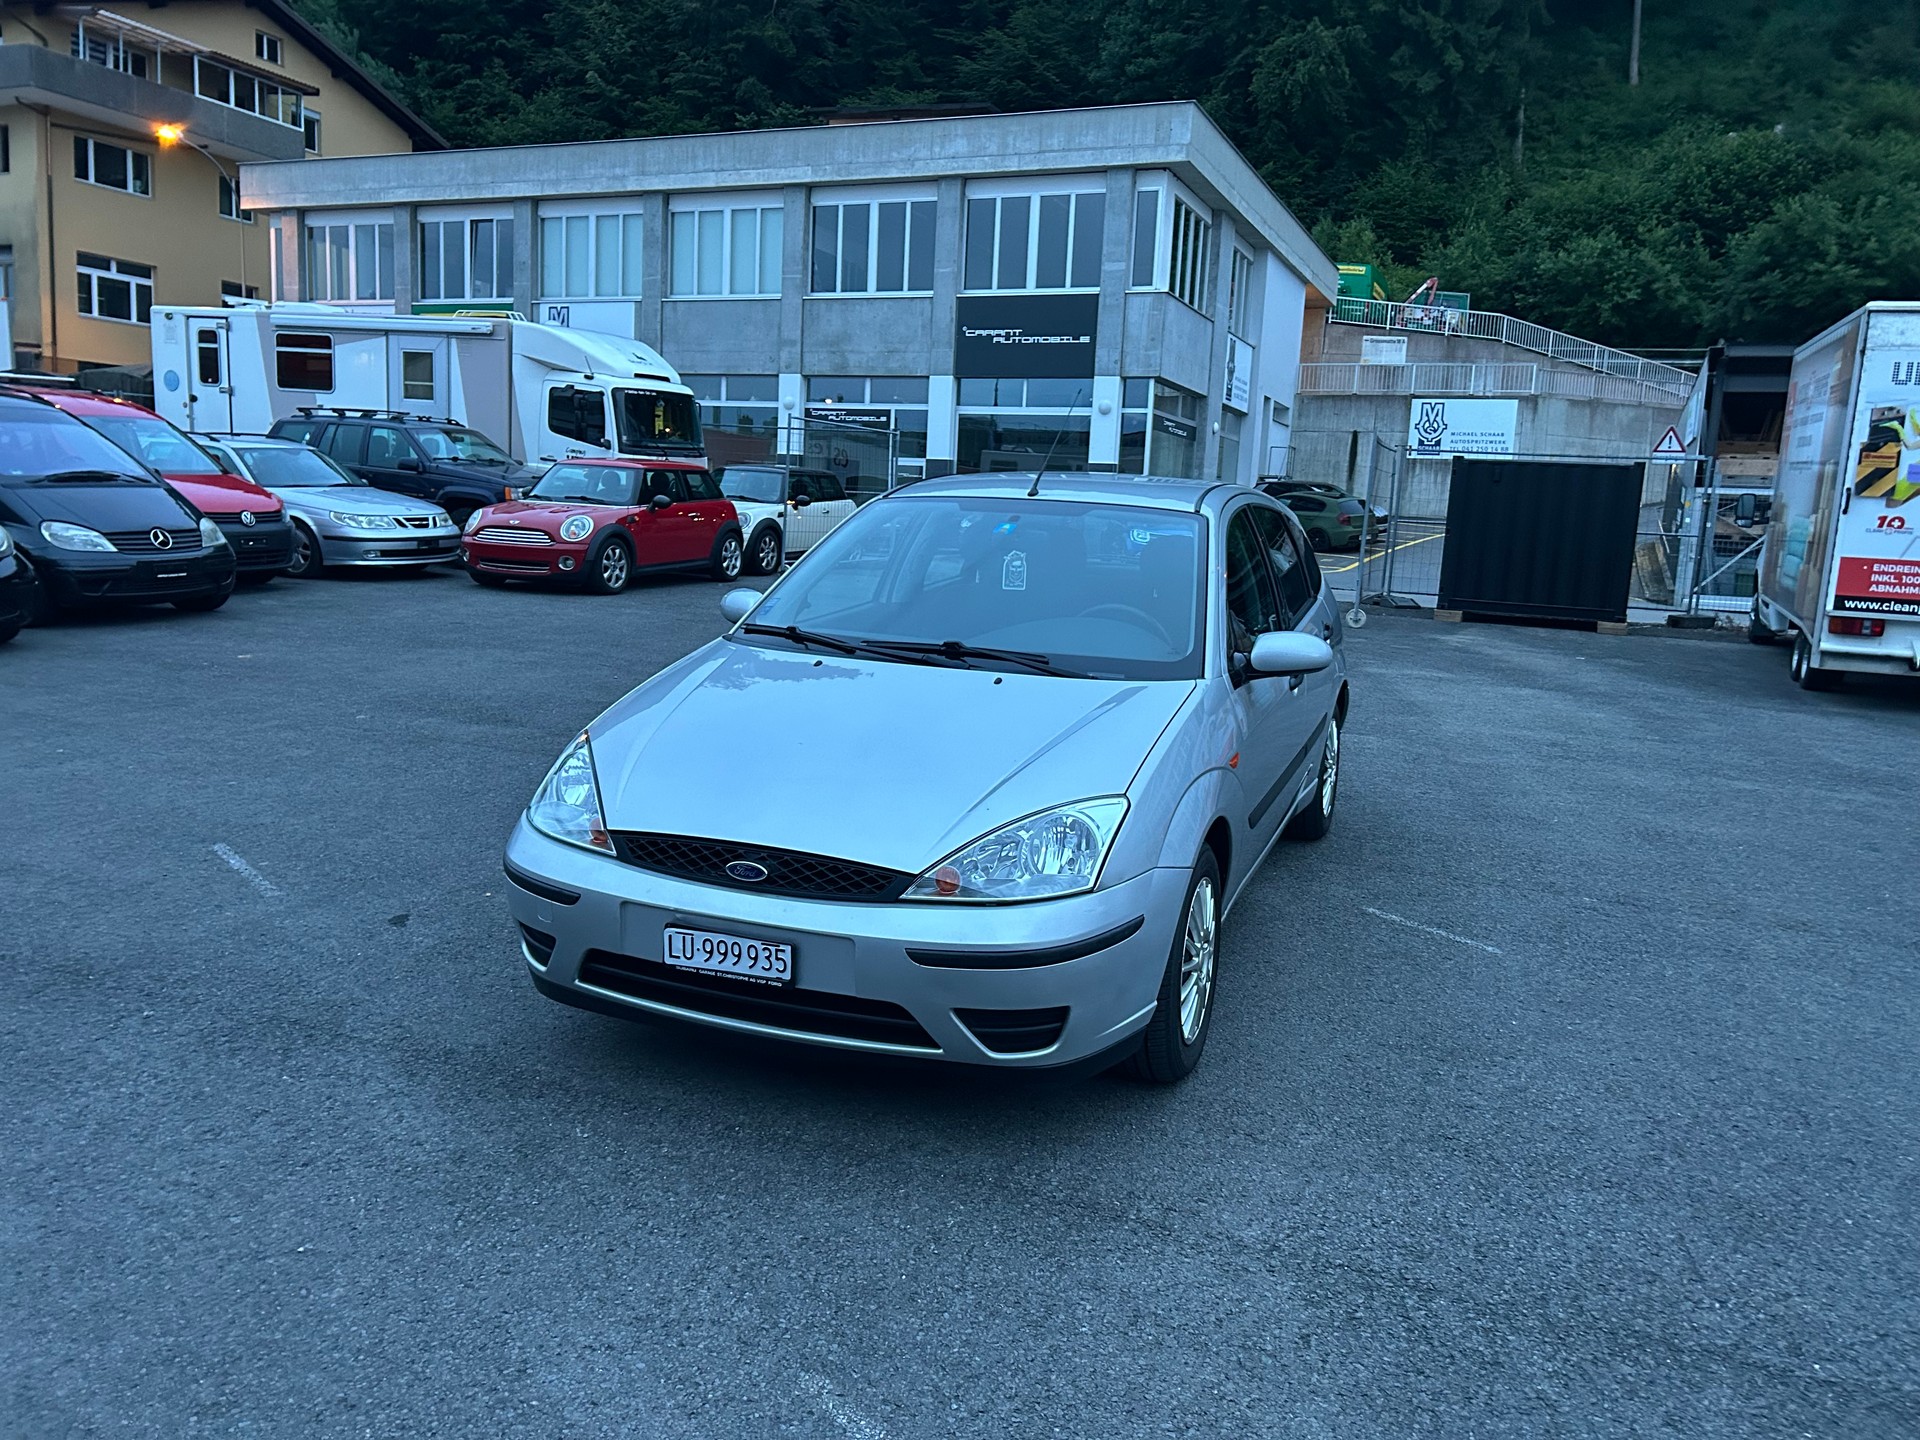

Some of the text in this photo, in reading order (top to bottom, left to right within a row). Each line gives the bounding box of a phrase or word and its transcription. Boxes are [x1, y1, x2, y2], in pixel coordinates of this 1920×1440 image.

[965, 329, 1023, 337] CARANT
[992, 335, 1091, 344] AUTOMOBILE
[1869, 584, 1920, 594] ABNAHM
